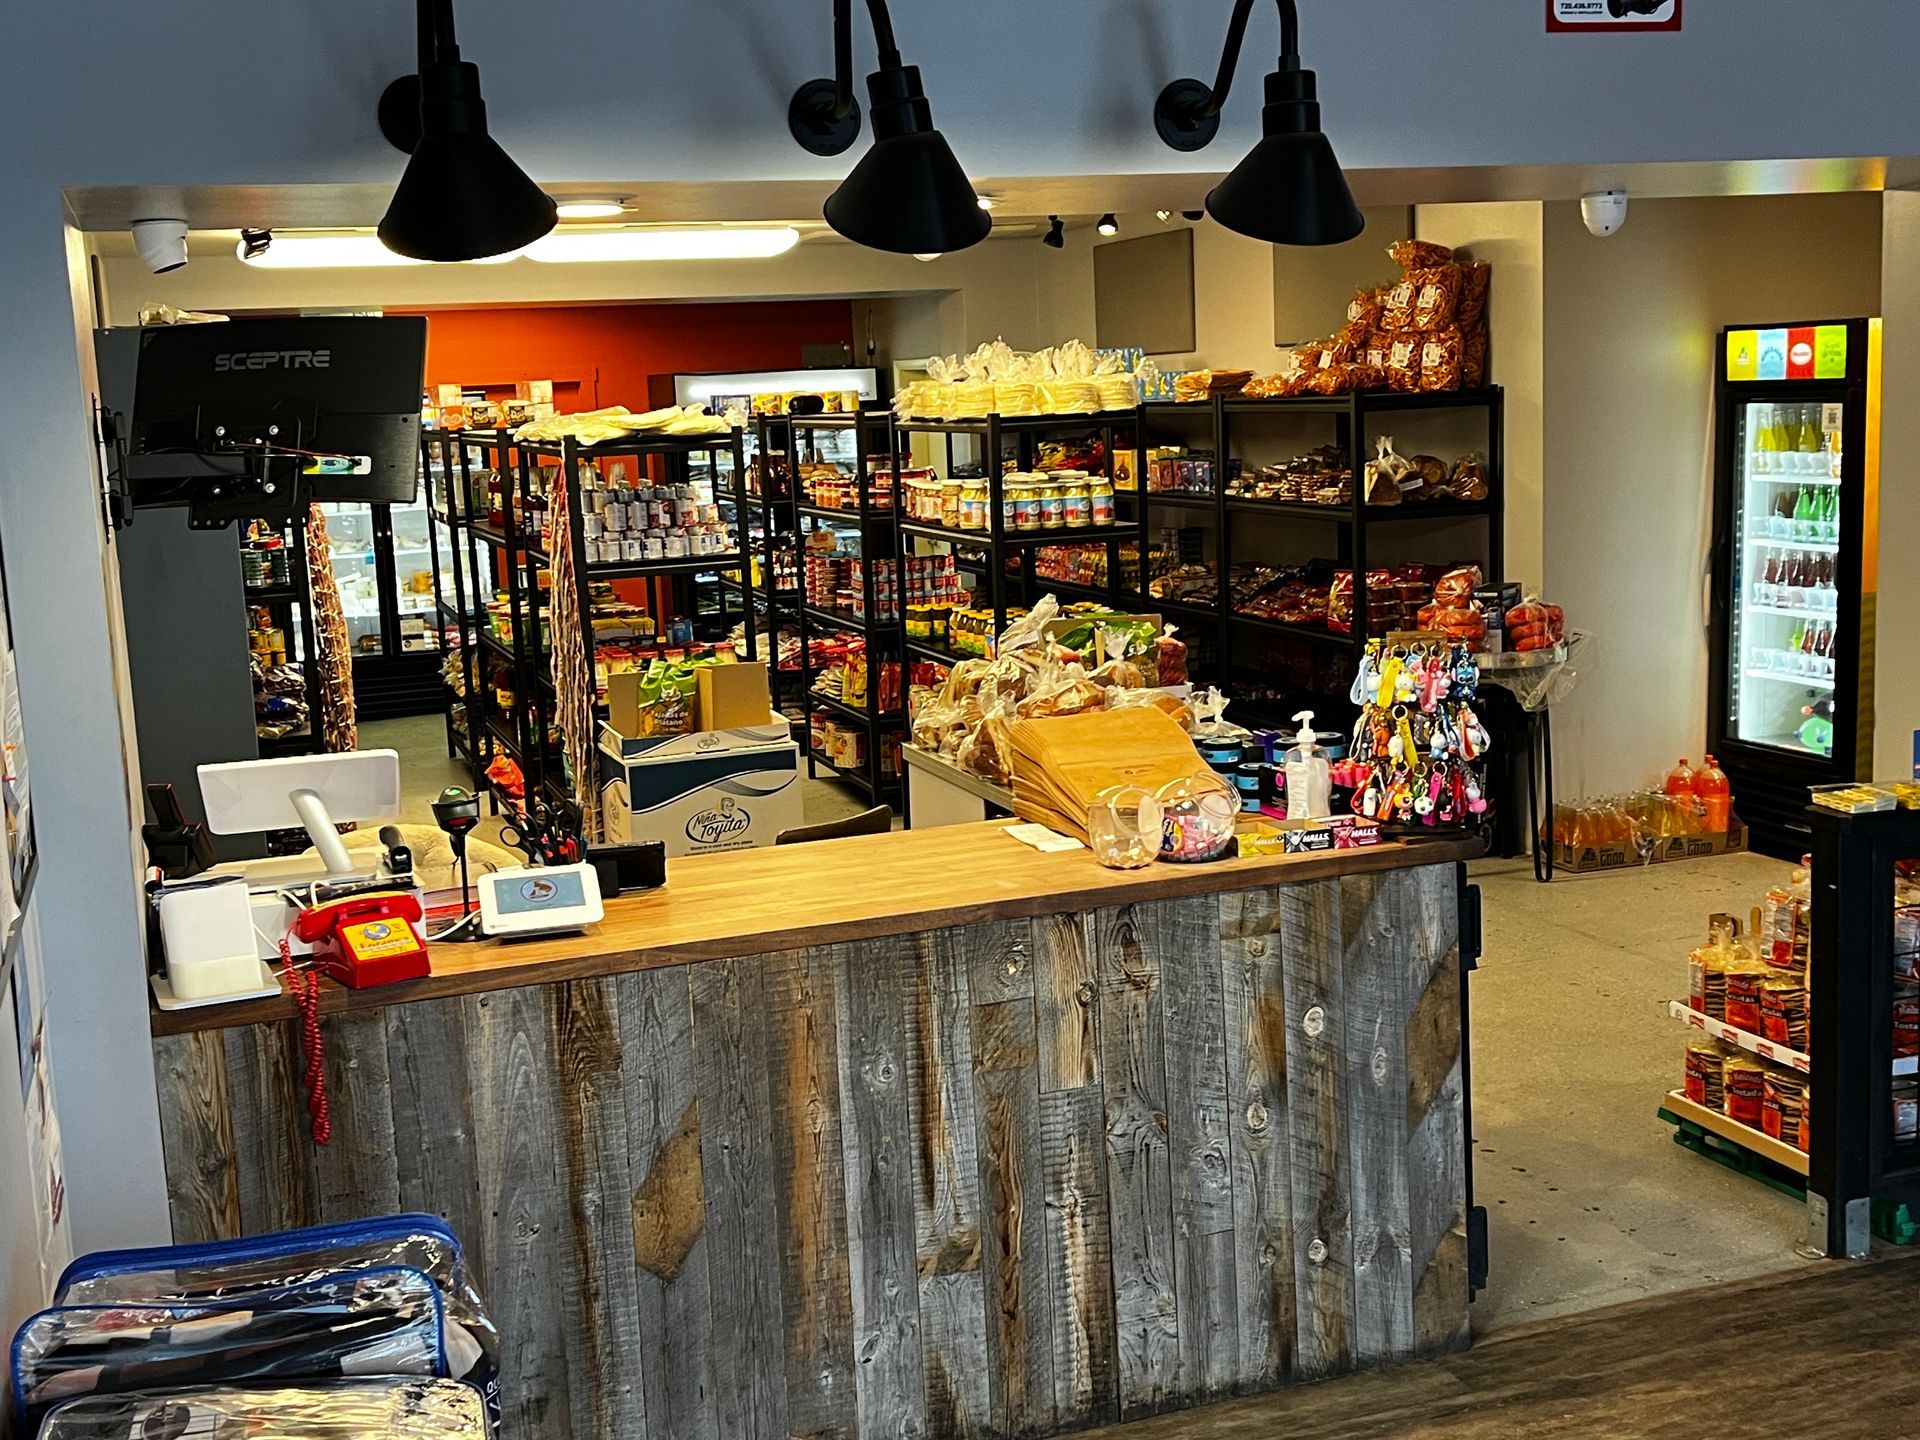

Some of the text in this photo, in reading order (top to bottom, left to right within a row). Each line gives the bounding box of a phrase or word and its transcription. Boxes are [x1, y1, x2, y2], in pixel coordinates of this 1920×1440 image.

[215, 350, 330, 372] SCEPTRE
[693, 811, 717, 830] Niña
[701, 818, 744, 843] Toyita
[1302, 832, 1330, 843] HALLS
[1351, 827, 1378, 838] HALLS
[1894, 1021, 1919, 1030] Tosta
